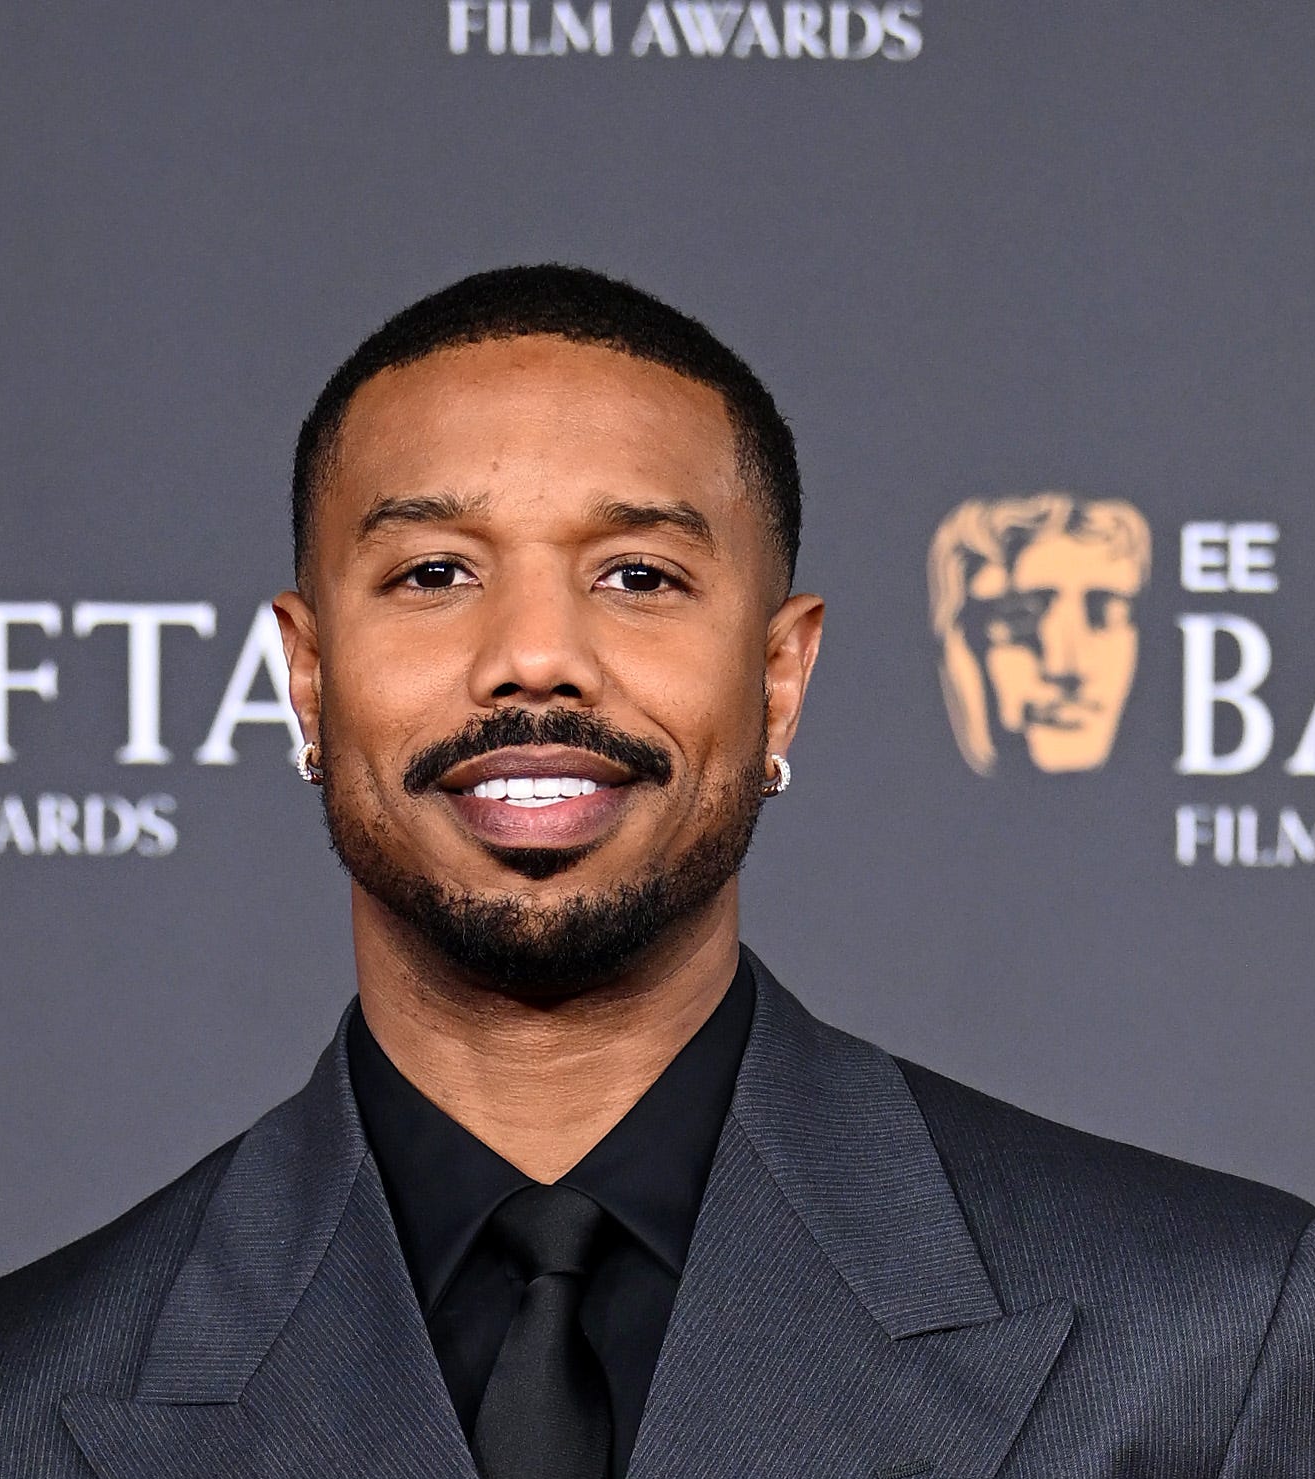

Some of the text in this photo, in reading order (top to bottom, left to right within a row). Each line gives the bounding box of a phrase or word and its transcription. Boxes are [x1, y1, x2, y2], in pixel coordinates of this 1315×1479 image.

[448, 0, 922, 60] FILM AWARDS
[1181, 522, 1279, 593] EE
